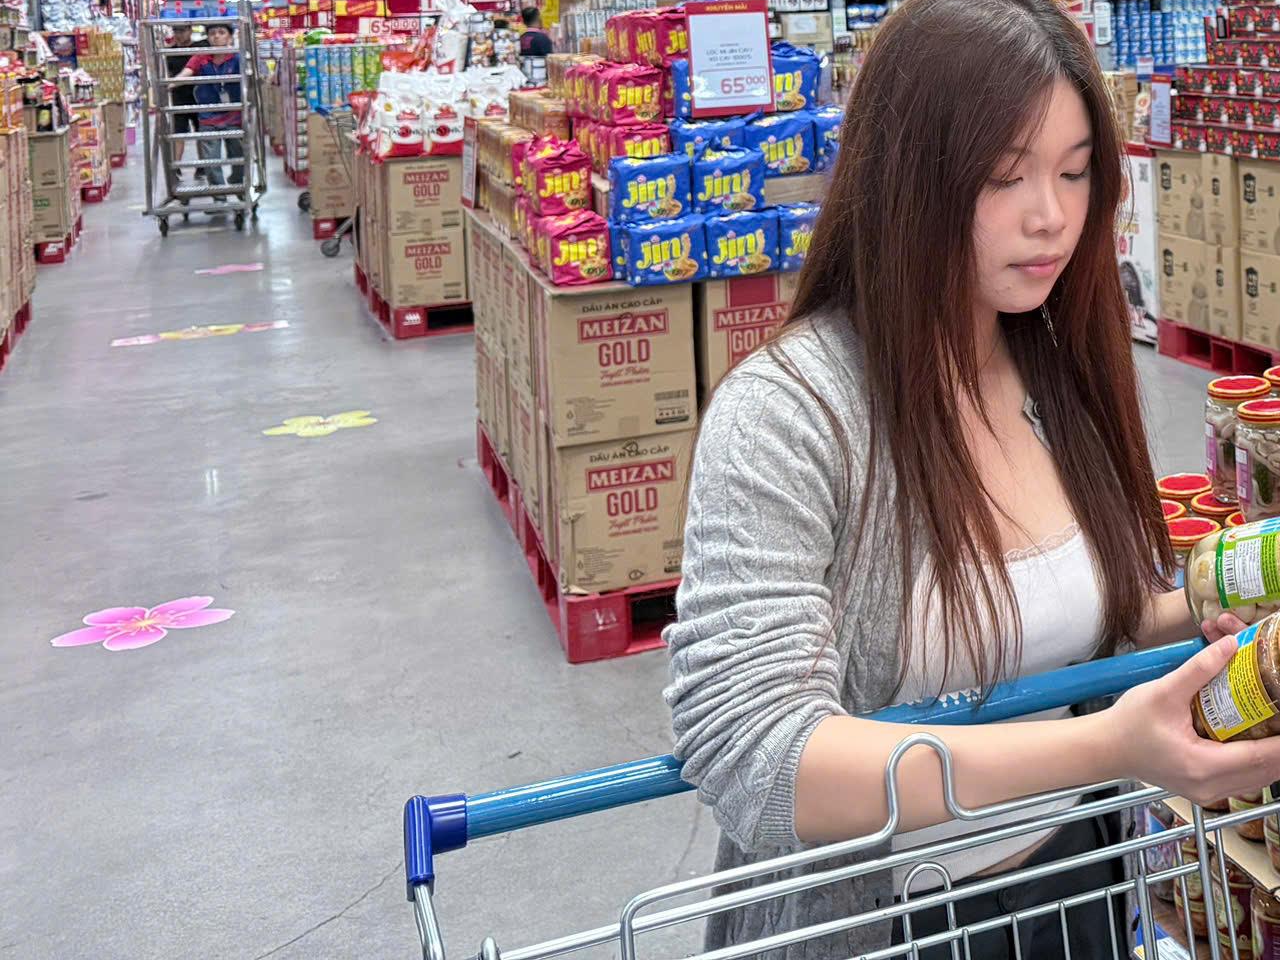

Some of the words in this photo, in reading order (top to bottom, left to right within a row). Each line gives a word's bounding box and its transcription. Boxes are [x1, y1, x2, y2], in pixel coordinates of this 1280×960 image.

[405, 172, 449, 184] MEIZAN
[413, 183, 441, 197] GOLD
[406, 244, 450, 255] MEIZAN
[415, 256, 442, 271] GOLD
[582, 313, 665, 339] MEIZAN
[718, 304, 789, 327] MEIZAN
[598, 338, 651, 368] GOLD
[590, 462, 672, 489] MEIZAN
[606, 486, 658, 517] GOLD
